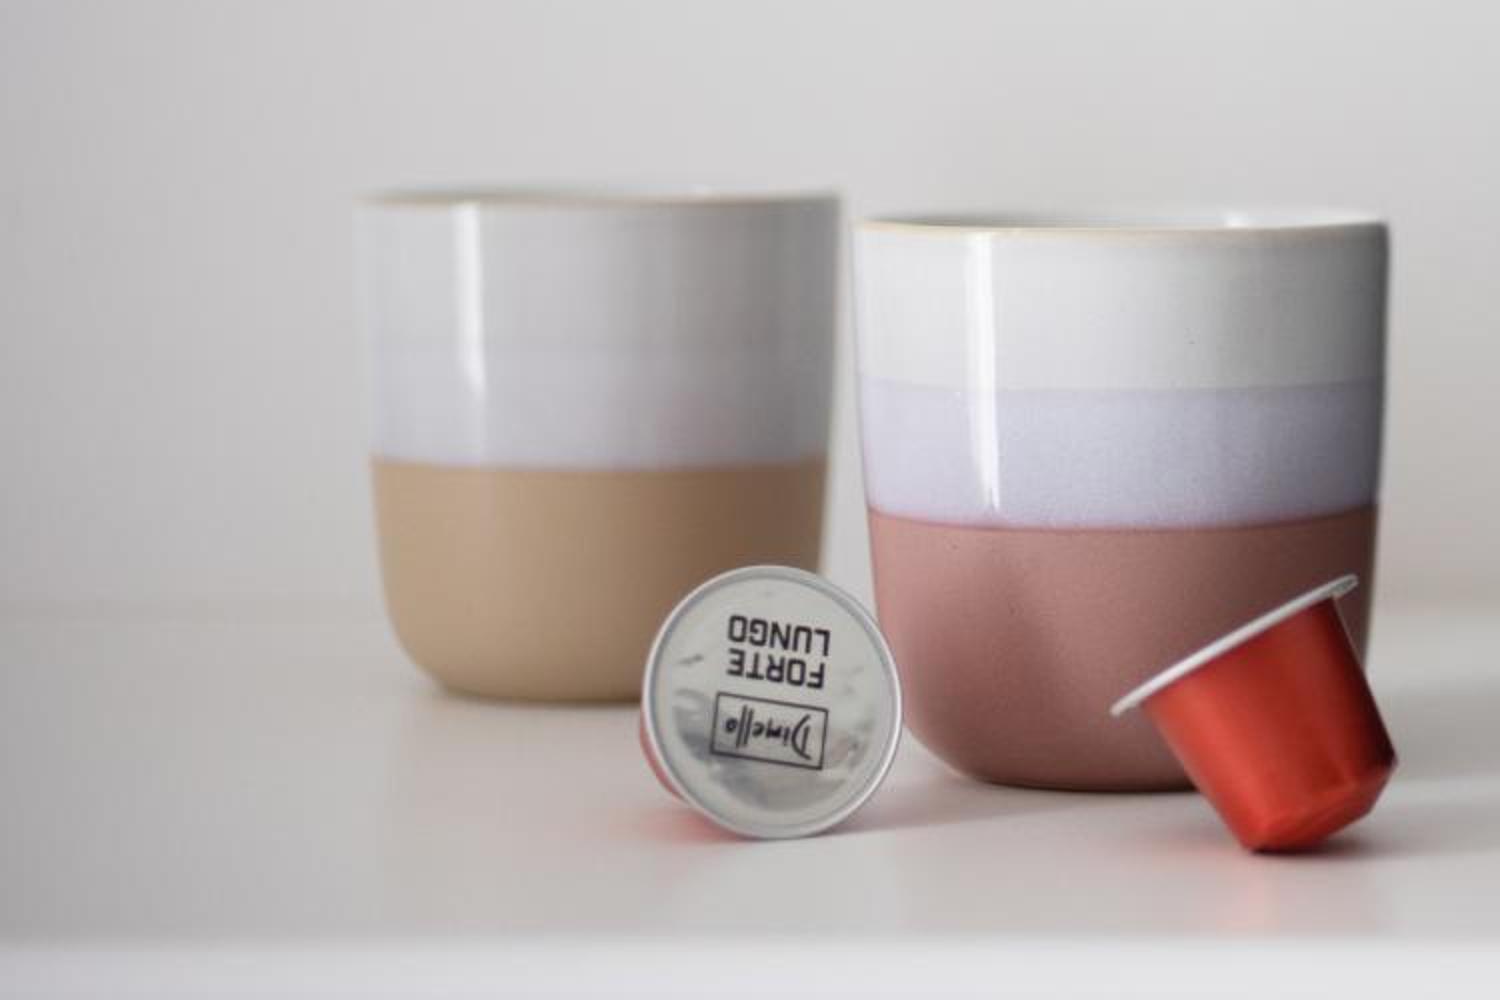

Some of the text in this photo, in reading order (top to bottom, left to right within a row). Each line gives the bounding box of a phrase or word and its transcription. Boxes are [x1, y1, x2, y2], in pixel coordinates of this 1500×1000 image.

[728, 614, 830, 657] LUNGO
[727, 648, 826, 690] FORTE
[725, 704, 813, 760] Dimello
